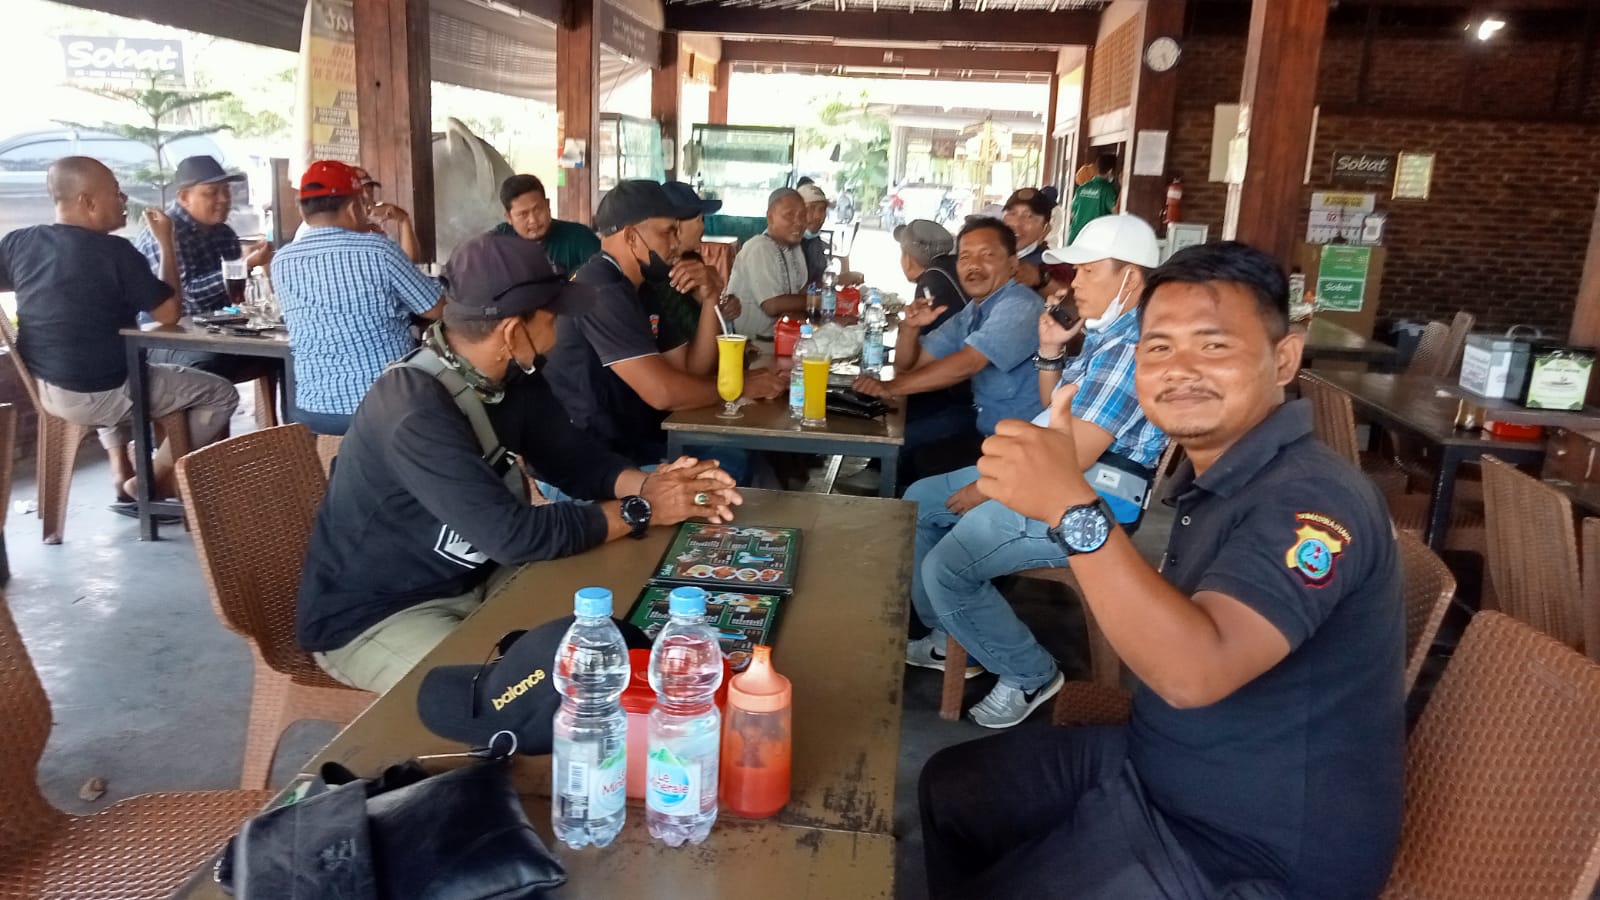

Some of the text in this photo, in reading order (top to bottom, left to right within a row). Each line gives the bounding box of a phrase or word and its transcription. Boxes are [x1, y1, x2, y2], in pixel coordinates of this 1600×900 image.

[68, 38, 178, 70] Sobat
[1335, 154, 1388, 172] Sobat
[491, 669, 545, 711] balance
